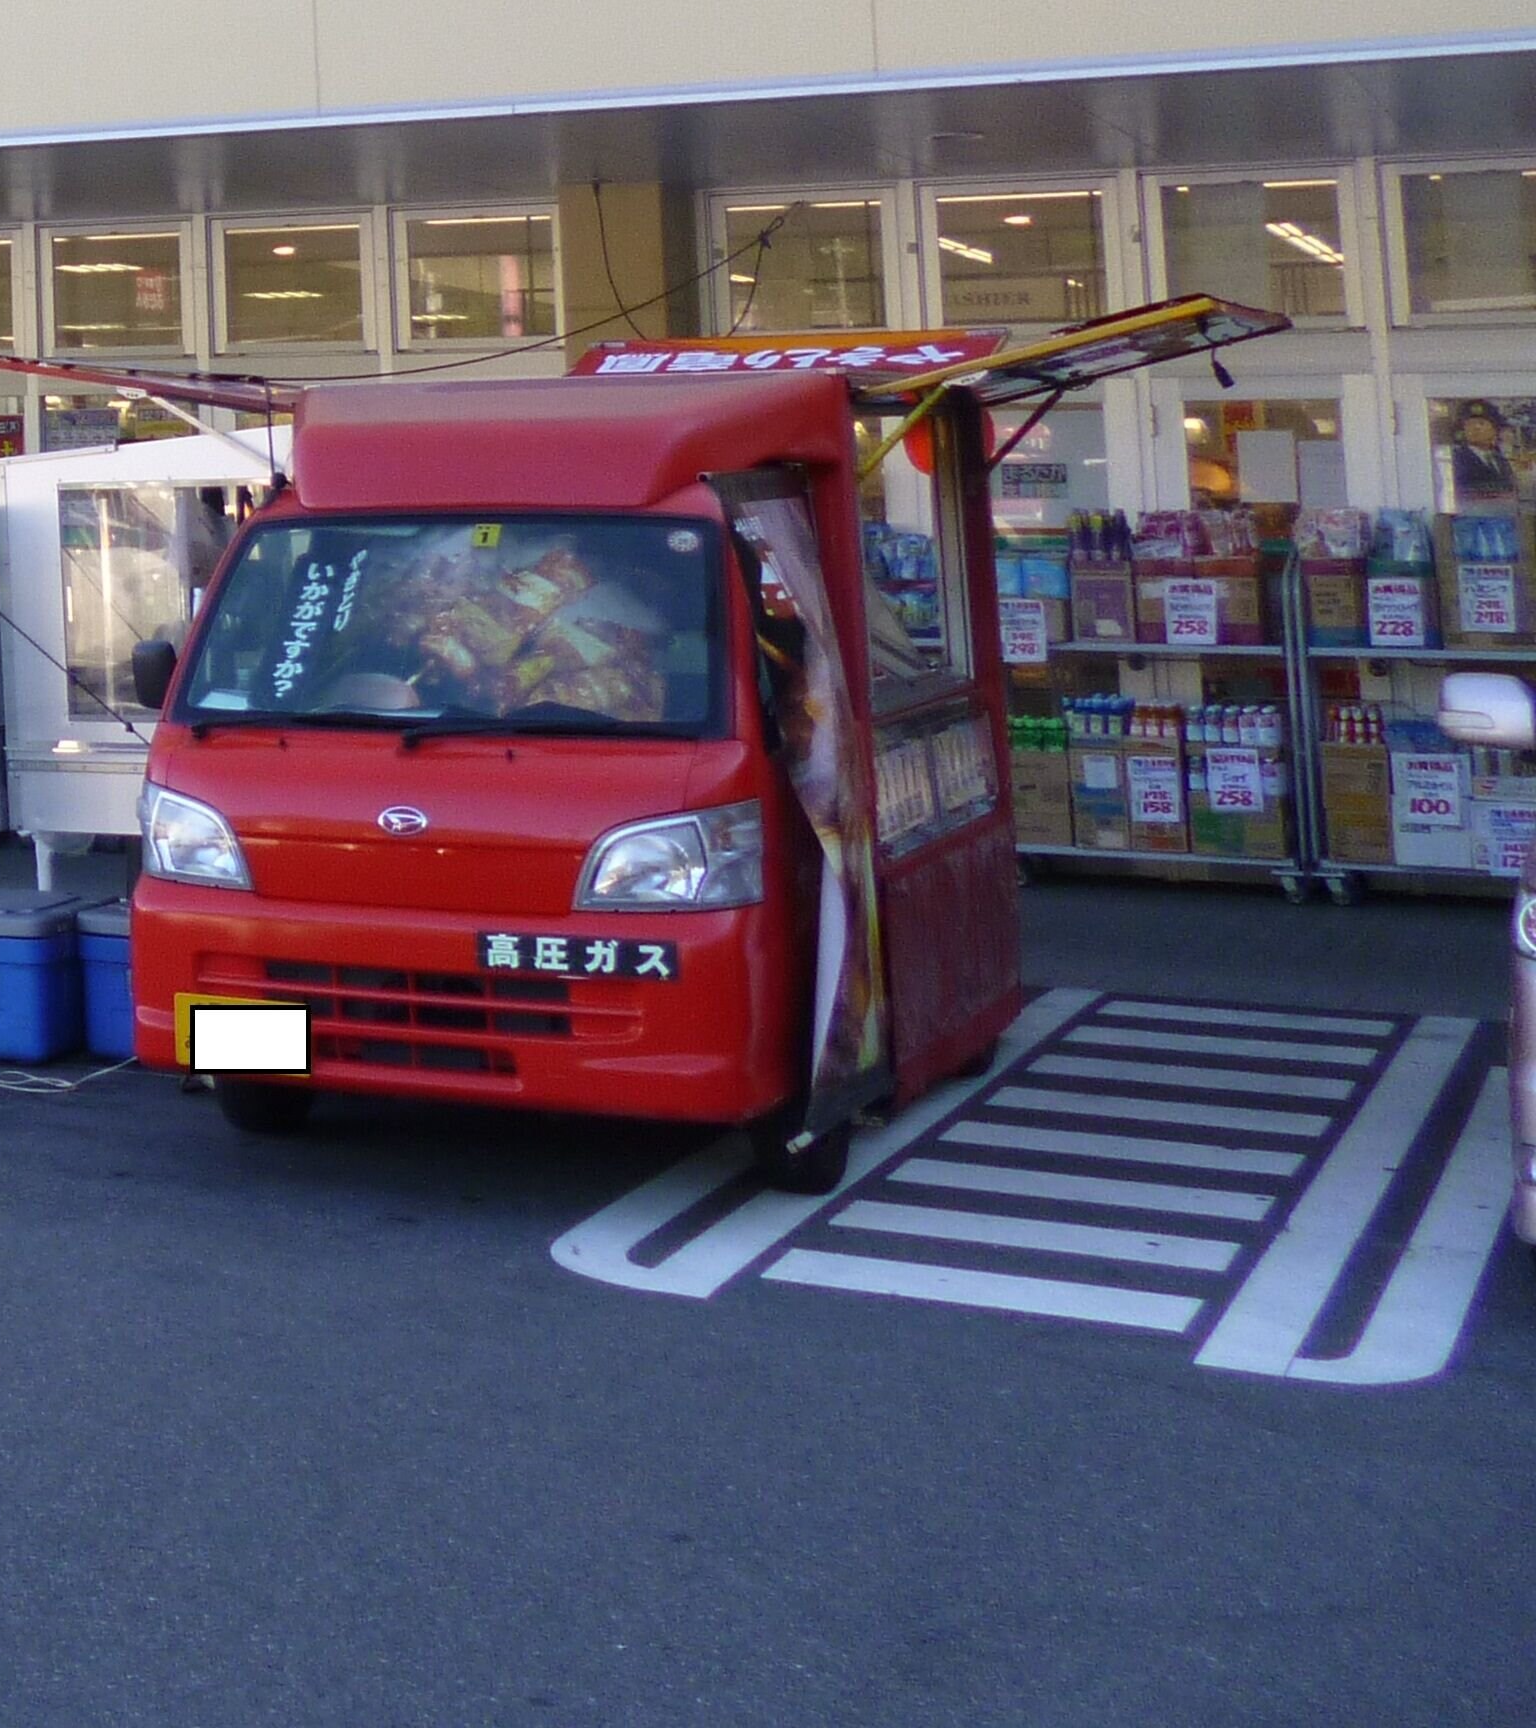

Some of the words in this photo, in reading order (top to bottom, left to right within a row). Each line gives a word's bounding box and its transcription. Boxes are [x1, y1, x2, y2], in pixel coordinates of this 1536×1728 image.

[1172, 620, 1209, 636] 258
[1375, 620, 1415, 637] 228
[1215, 791, 1253, 807] 258
[1409, 798, 1452, 816] 100
[1142, 802, 1172, 814] 158
[486, 933, 671, 976] 高圧ガス
